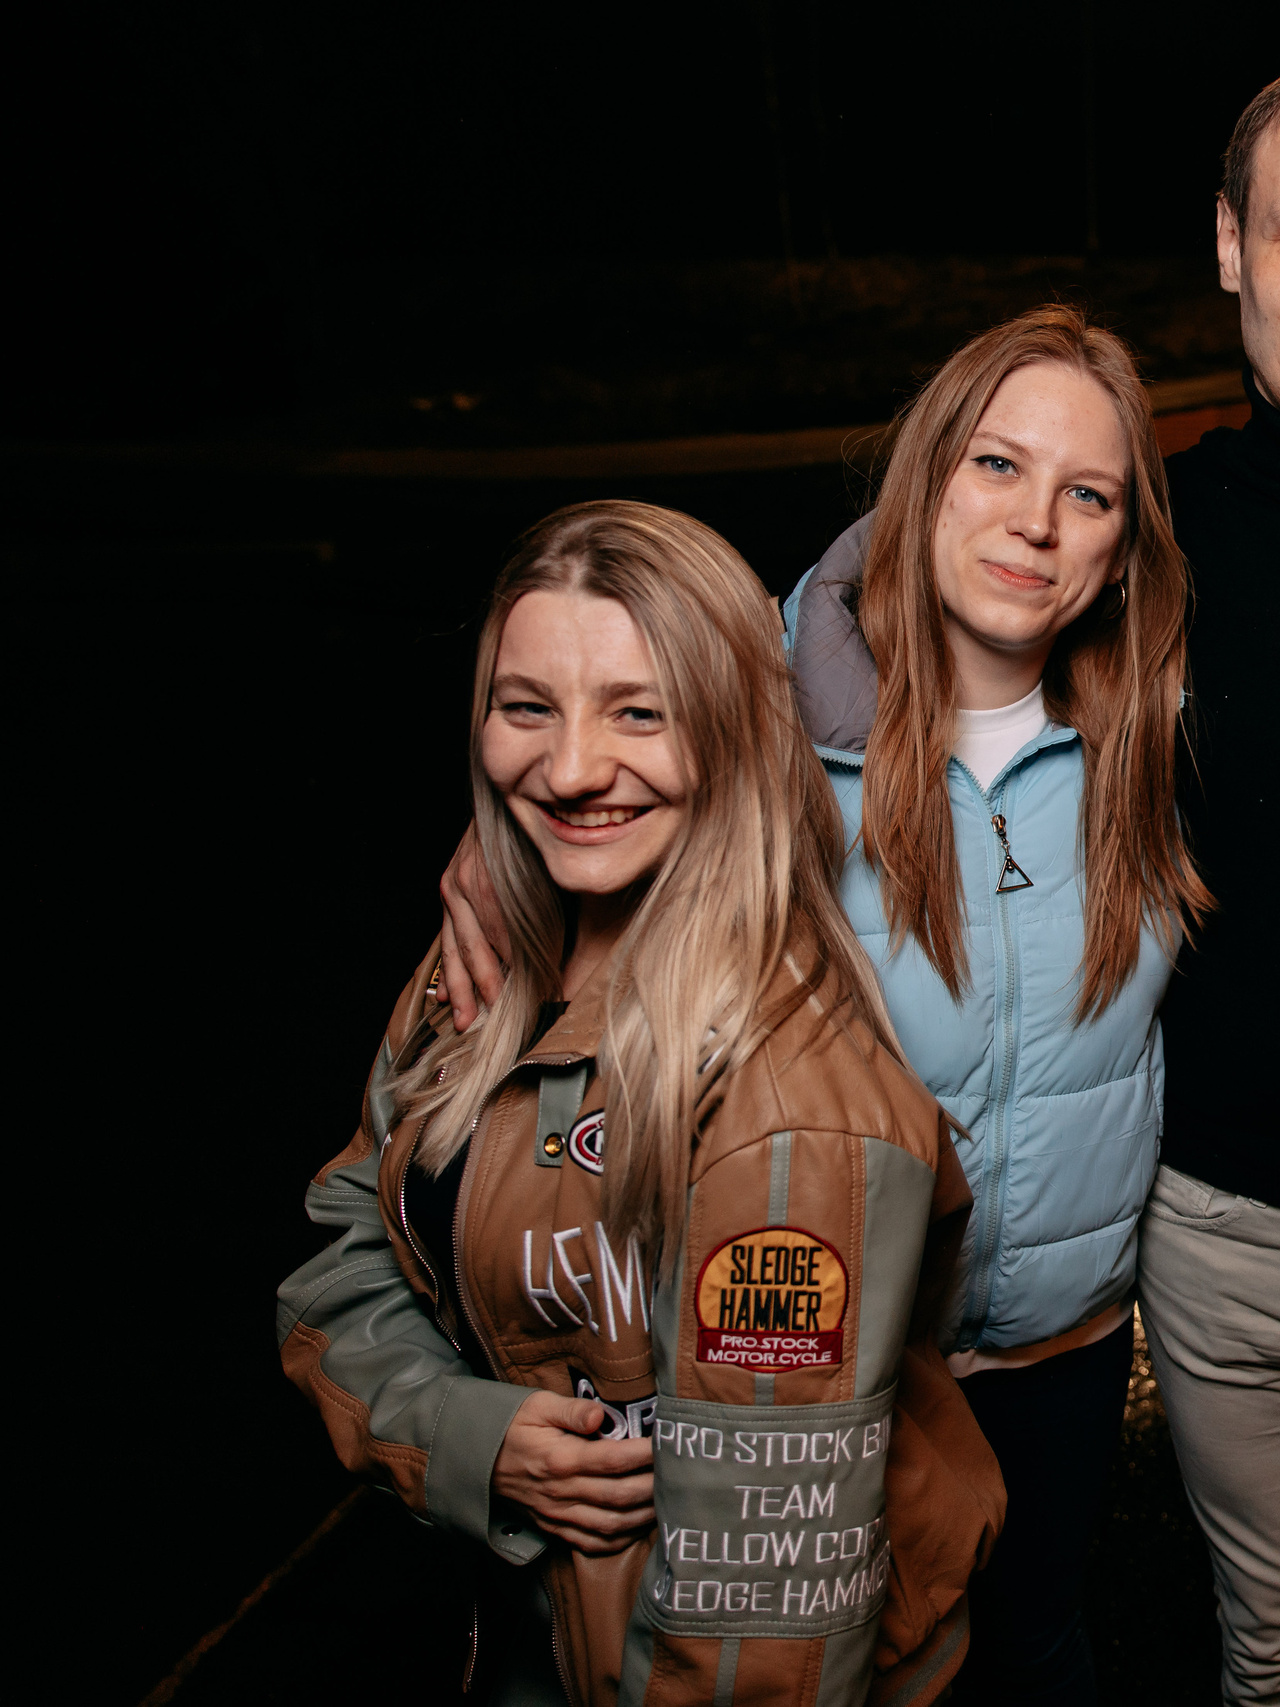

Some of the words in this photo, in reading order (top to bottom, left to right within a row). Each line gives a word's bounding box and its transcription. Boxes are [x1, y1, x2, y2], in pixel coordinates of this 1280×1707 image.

[731, 1245, 823, 1286] SLEDGE
[719, 1288, 822, 1331] HAMMER
[655, 1418, 723, 1460] PRO
[735, 1429, 855, 1467] STOCK
[734, 1482, 836, 1520] TEAM
[662, 1522, 806, 1567] YELLOW
